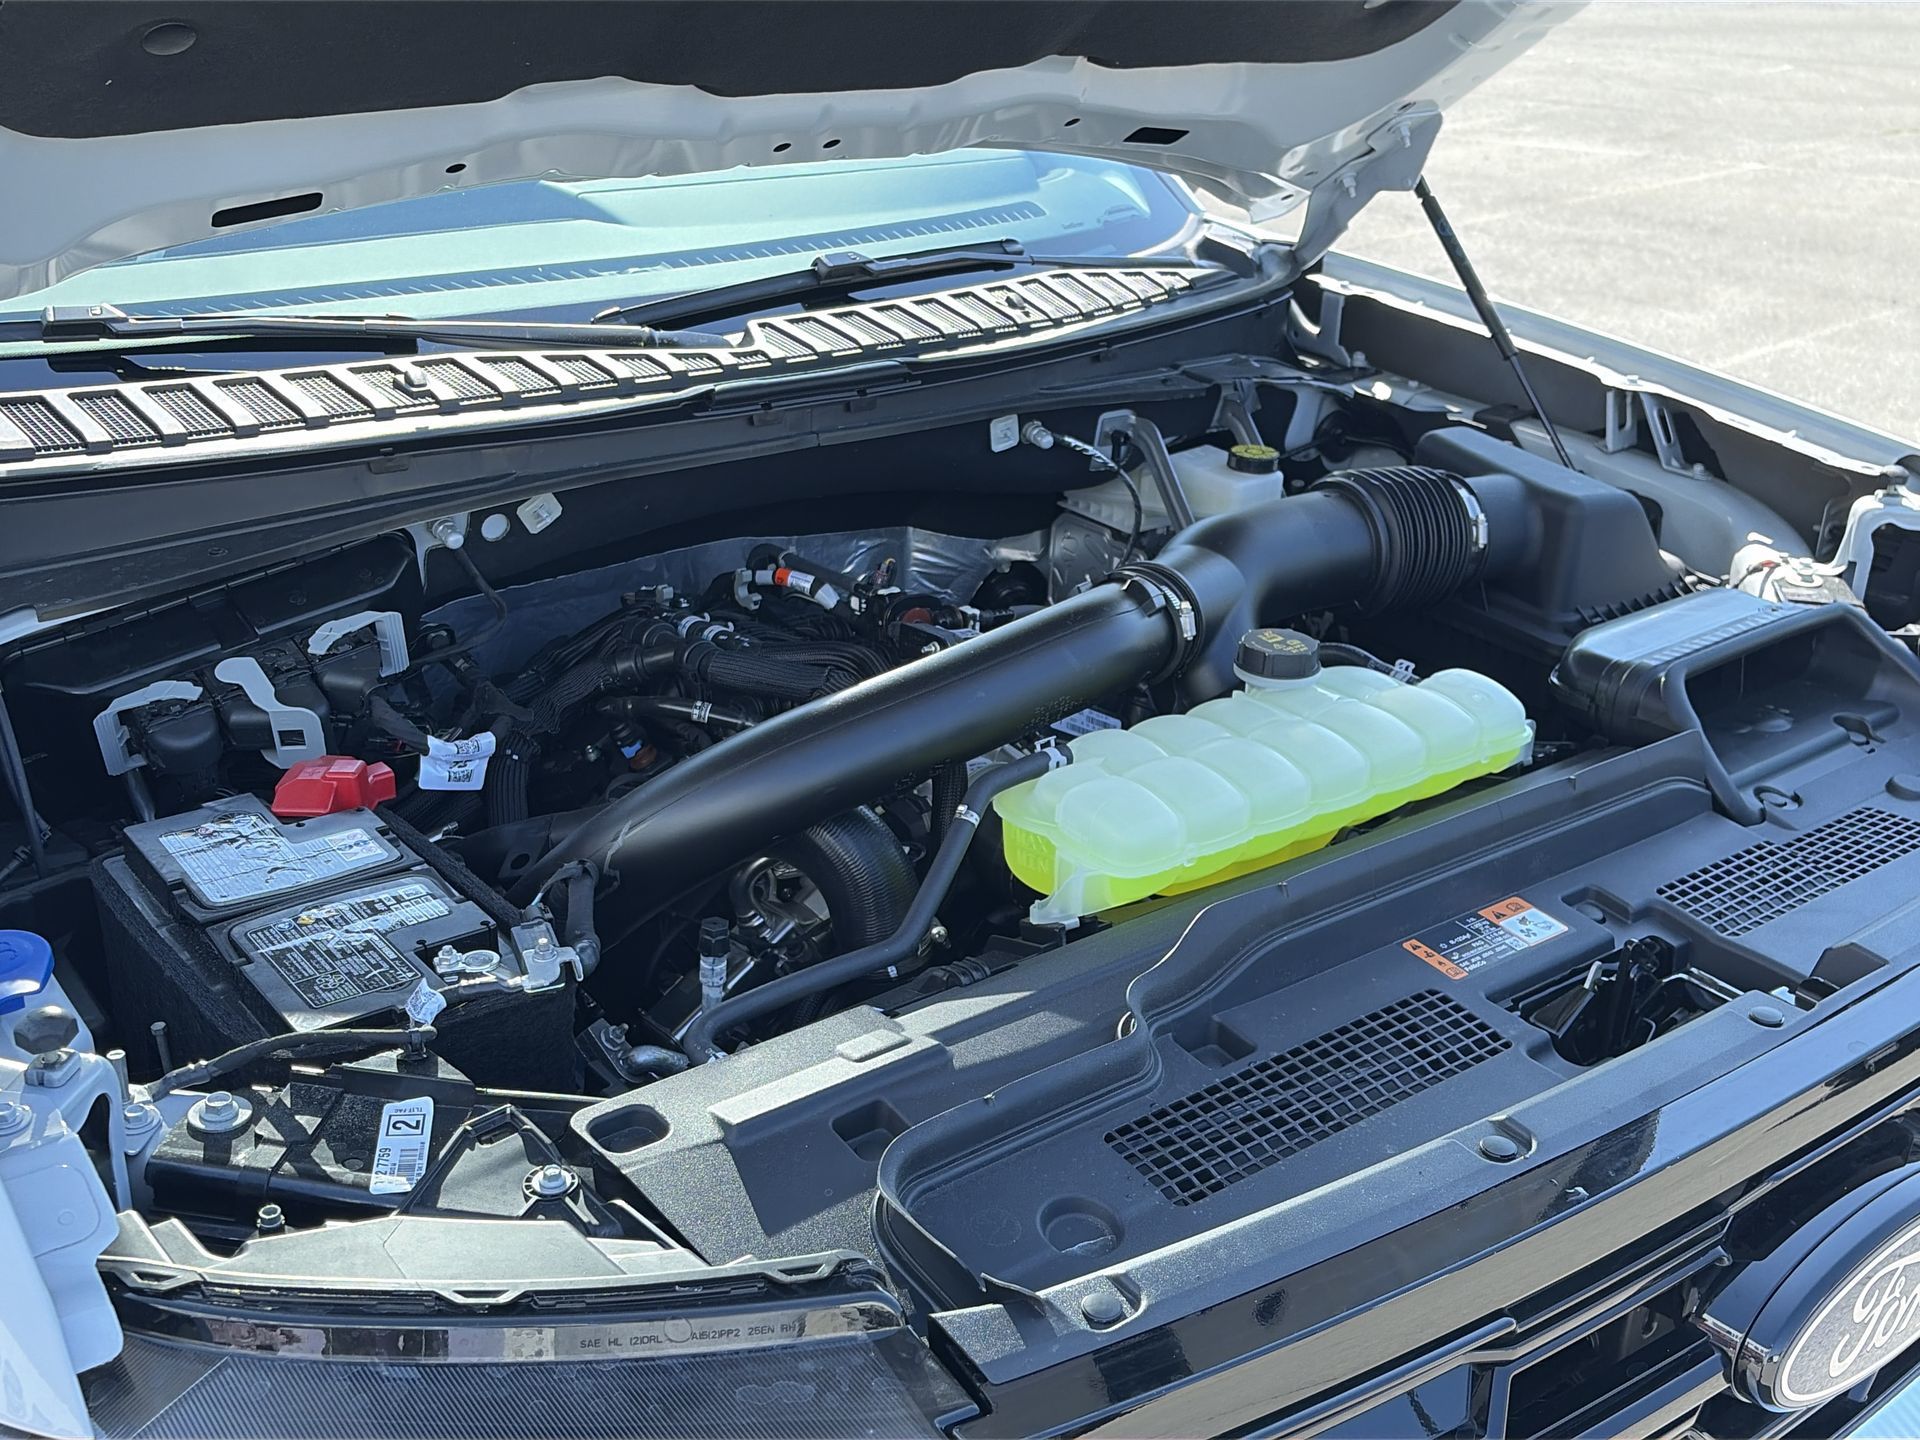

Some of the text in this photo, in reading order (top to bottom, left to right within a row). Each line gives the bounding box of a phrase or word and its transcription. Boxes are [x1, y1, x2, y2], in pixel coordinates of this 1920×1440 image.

[391, 1119, 421, 1131] 2
[376, 1147, 391, 1168] 7759
[580, 1338, 601, 1348] SAE
[608, 1338, 623, 1347] HL
[630, 1335, 663, 1346] (2)DRL
